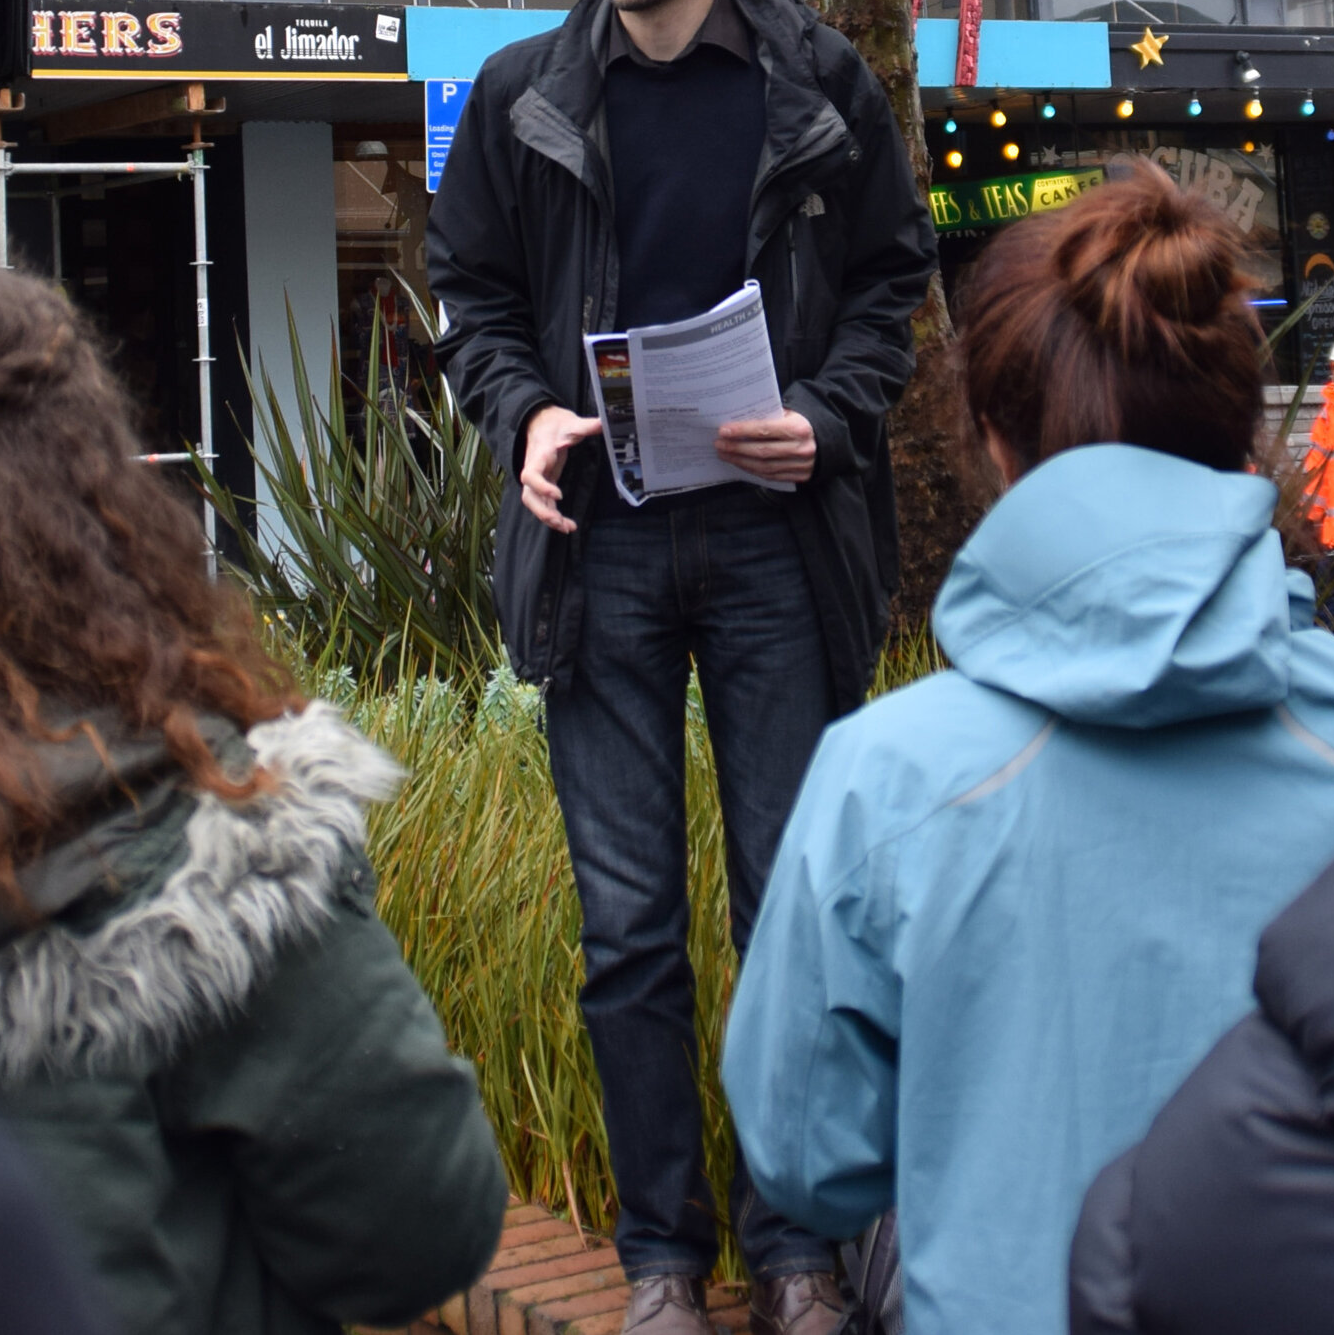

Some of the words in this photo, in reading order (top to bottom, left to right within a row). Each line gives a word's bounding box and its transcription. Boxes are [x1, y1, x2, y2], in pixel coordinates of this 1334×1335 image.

[32, 10, 184, 59] HERS
[295, 19, 329, 28] TEQUILA
[254, 25, 274, 60] el
[443, 82, 458, 103] P
[930, 191, 962, 225] EES
[968, 200, 982, 221] &
[981, 182, 1029, 219] TEAS
